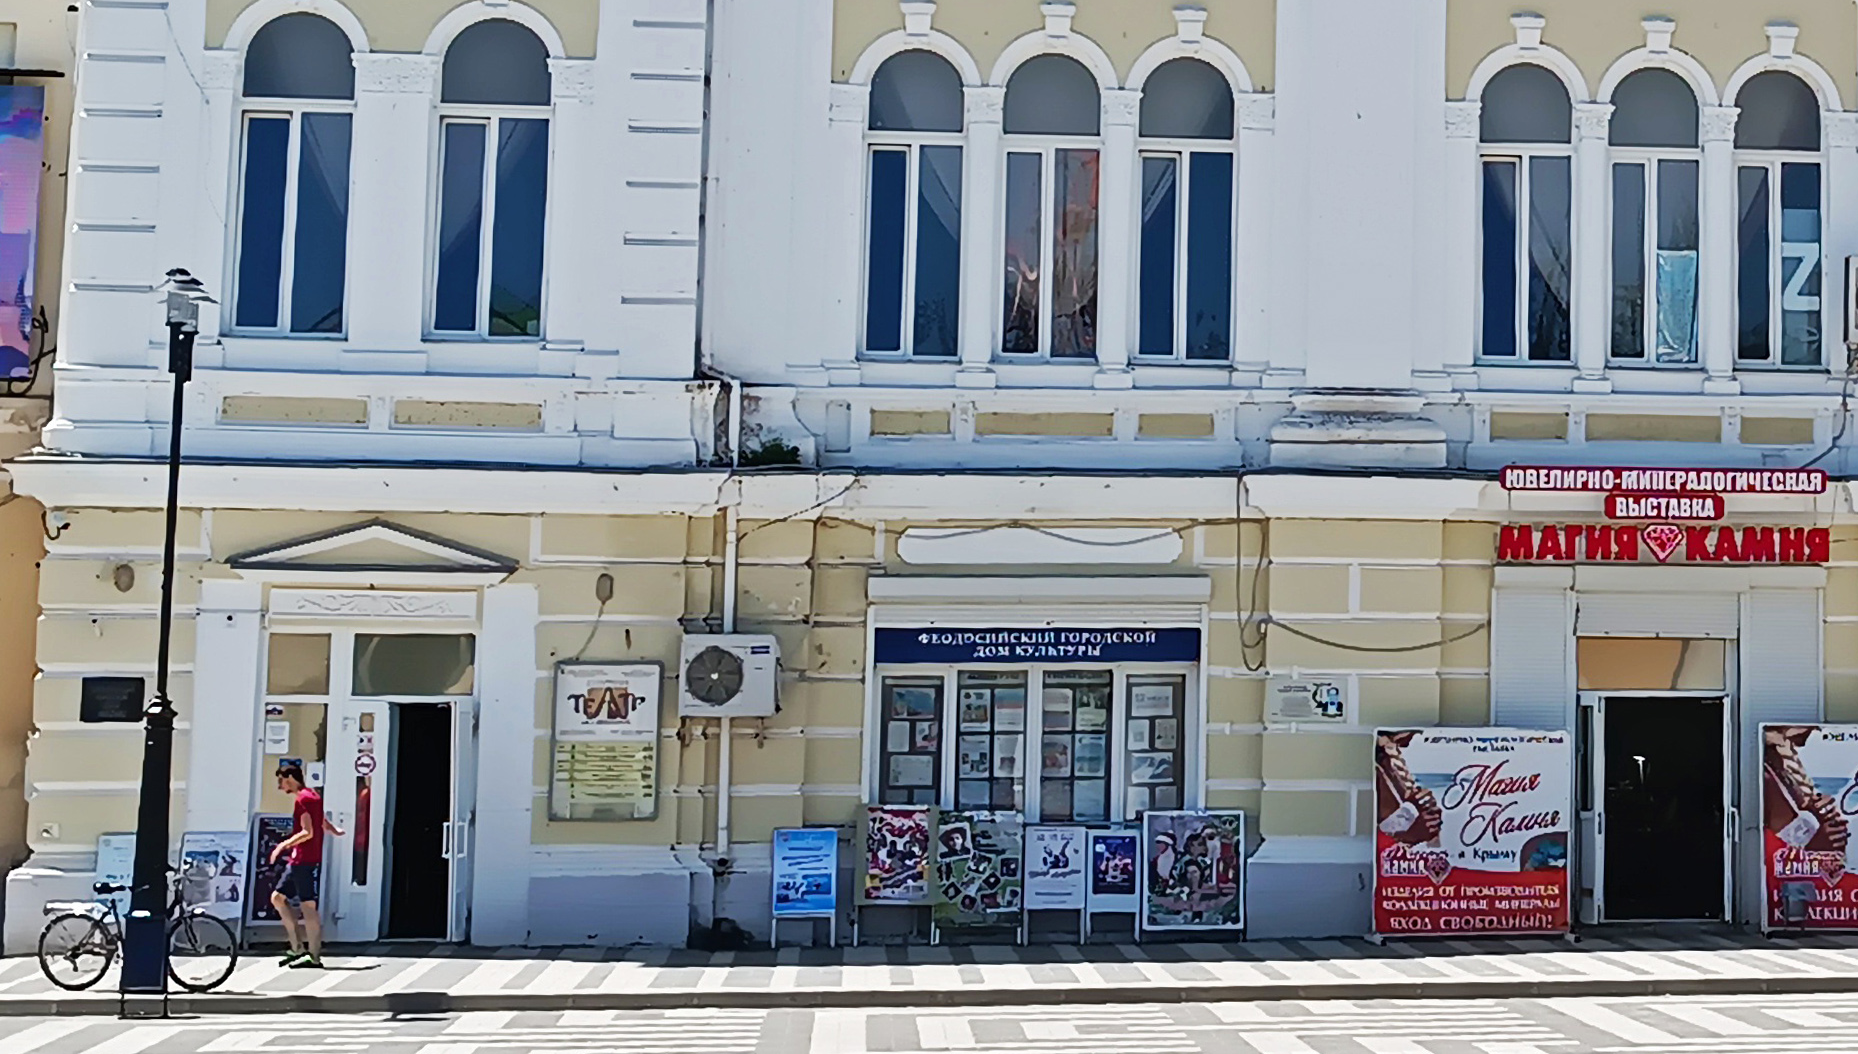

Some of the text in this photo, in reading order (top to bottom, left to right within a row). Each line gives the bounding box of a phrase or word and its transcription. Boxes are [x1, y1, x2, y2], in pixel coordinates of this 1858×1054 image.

[1505, 469, 1823, 491] ЮВЕЛИРНО-МИНЕРАЛОГИЧЕСКАЯ
[1615, 497, 1715, 517] ВЫСТАВКА
[1500, 525, 1830, 562] МАГИЯ КАМНЯ
[918, 632, 1156, 645] ФЕОДОСИЙСКИЙ ГОРОДСКОЙ
[973, 645, 1101, 658] ДОМ КУЛЬТУРЫ
[567, 687, 646, 719] ТЕАТР
[1442, 759, 1541, 810] Магия
[1460, 801, 1561, 847] Камня
[1439, 885, 1457, 896] ОТ
[1390, 916, 1432, 929] ВХОД
